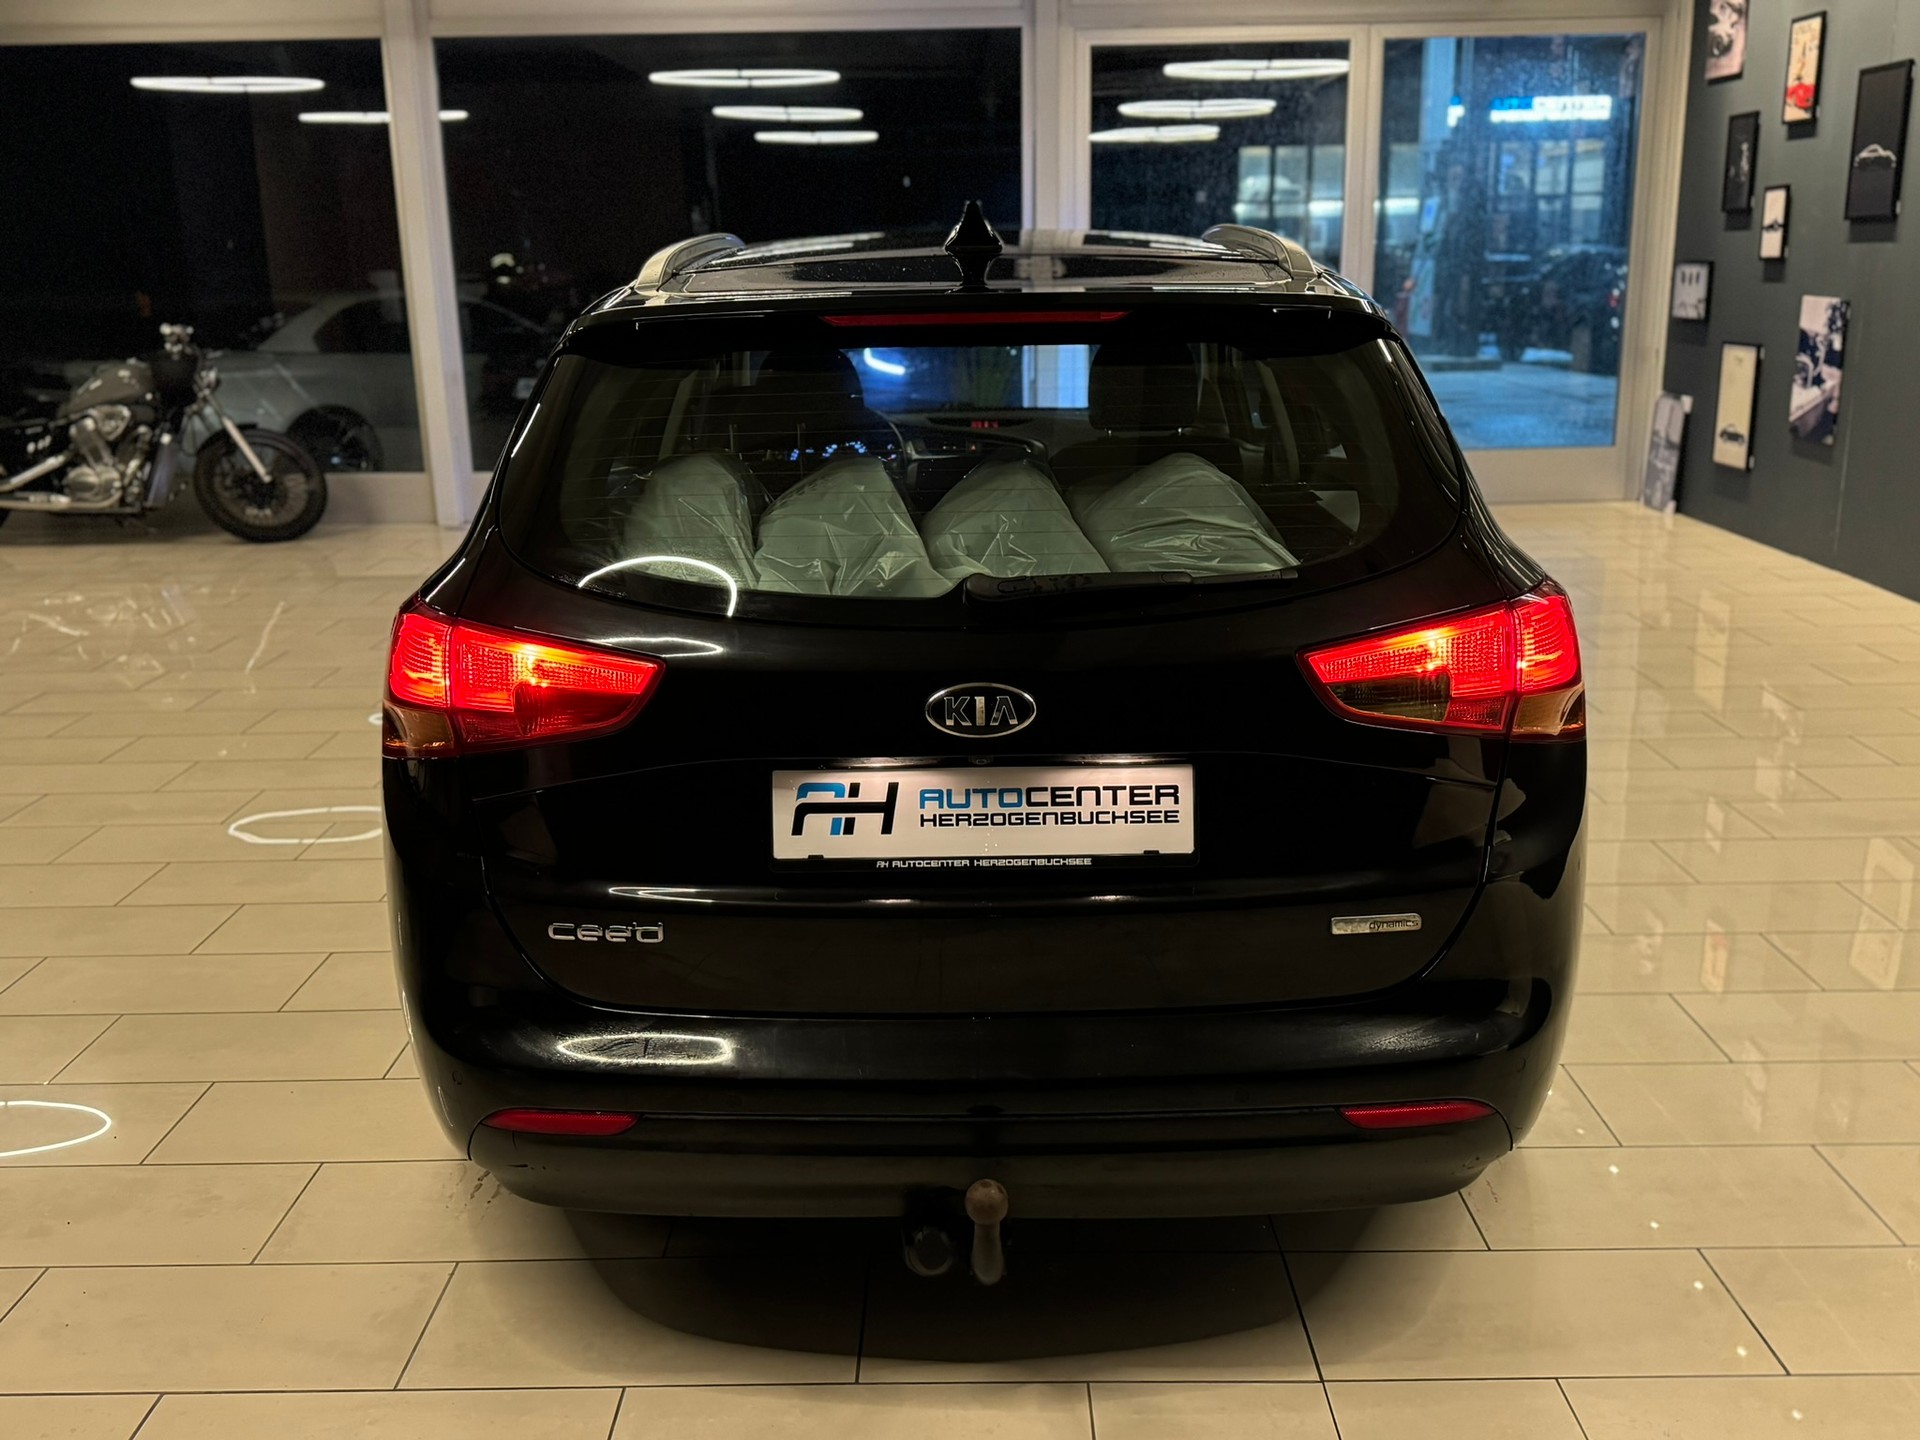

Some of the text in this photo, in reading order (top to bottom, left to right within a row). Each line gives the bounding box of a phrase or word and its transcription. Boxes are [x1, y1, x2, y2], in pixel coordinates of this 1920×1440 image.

[943, 696, 1018, 726] KIA
[919, 785, 1180, 809] AUTOCENTER
[920, 810, 1180, 828] HERZOGENBUCHSEE
[892, 859, 970, 869] AUTOCENTER
[974, 858, 1092, 867] HERZOGENBUCHSEE
[547, 921, 664, 943] cee'd
